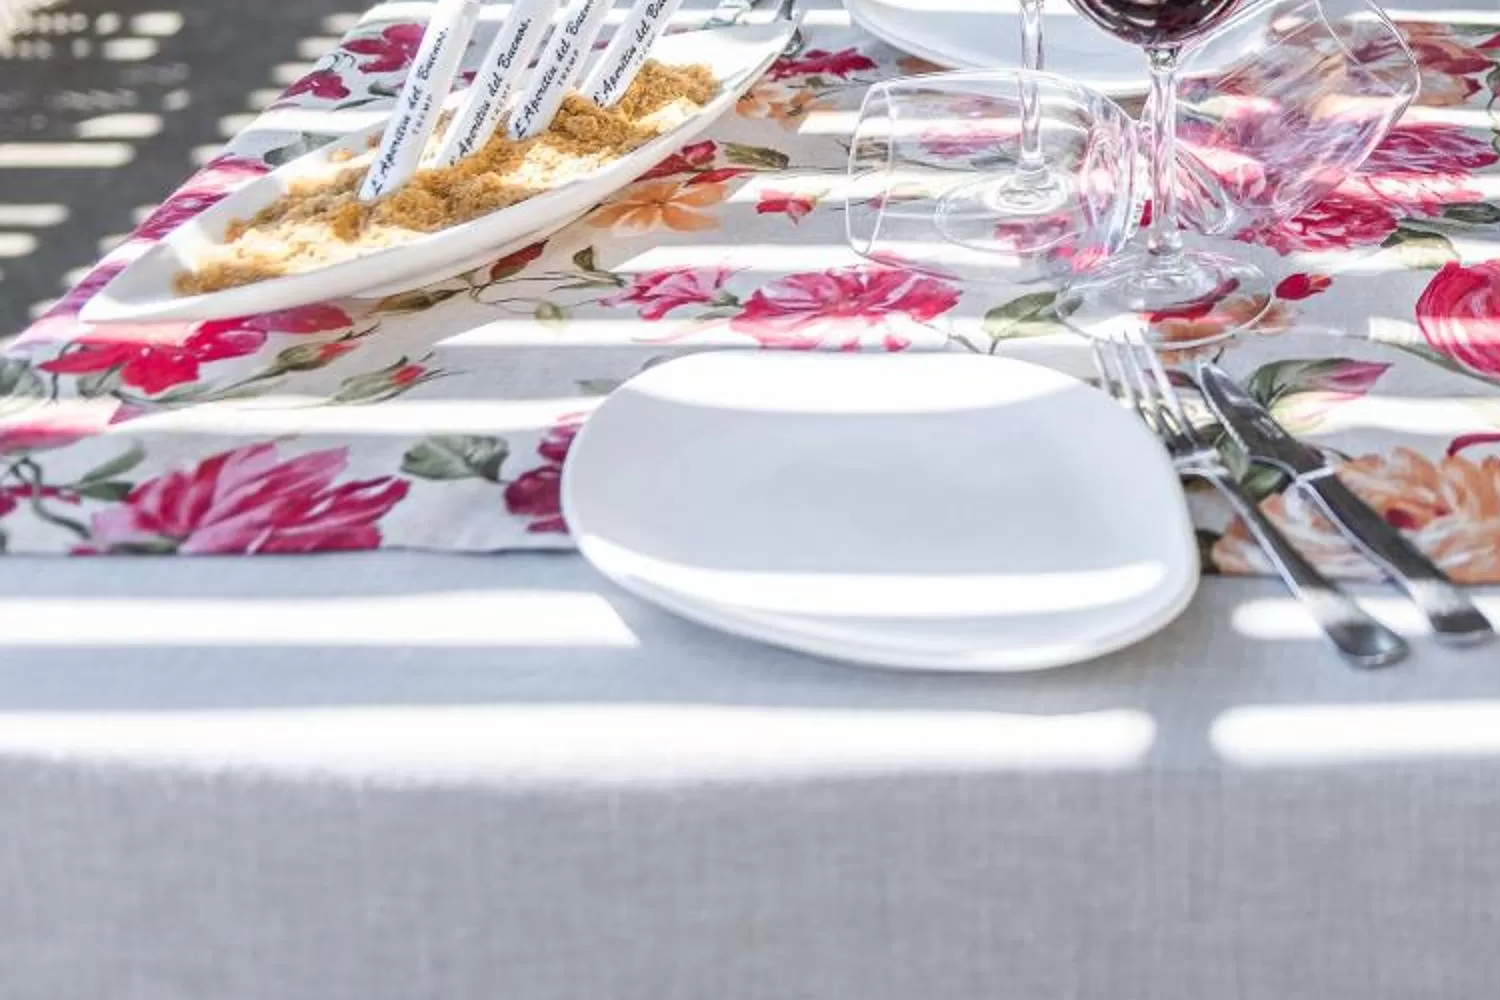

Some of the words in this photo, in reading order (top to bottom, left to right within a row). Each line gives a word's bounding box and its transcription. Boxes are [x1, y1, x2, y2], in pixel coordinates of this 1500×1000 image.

[635, 20, 650, 42] del
[556, 39, 571, 62] del
[488, 72, 503, 96] del
[408, 85, 421, 109] del
